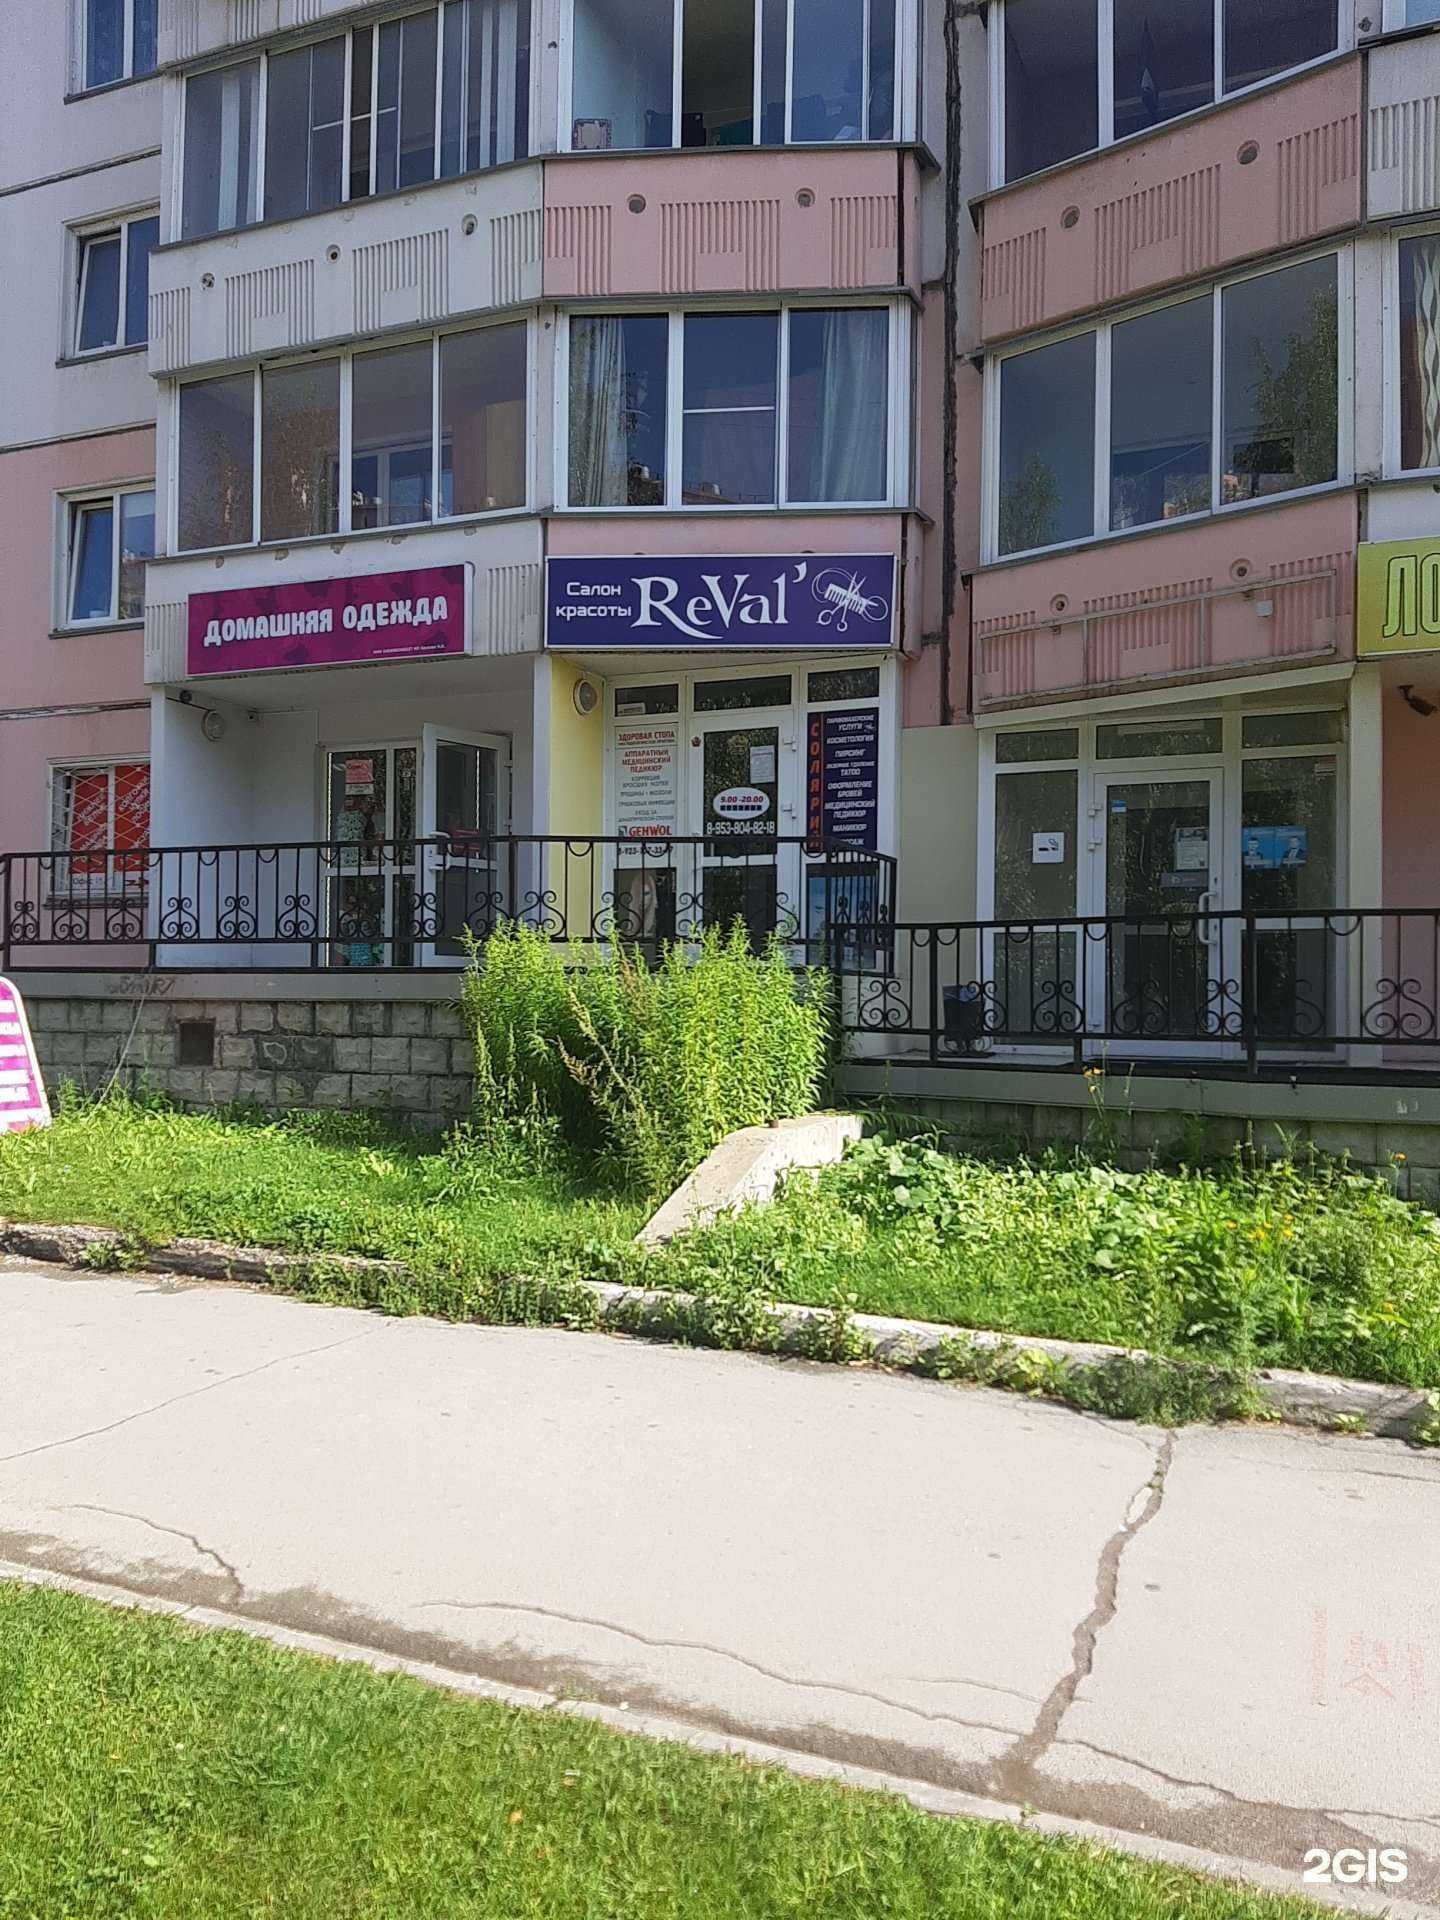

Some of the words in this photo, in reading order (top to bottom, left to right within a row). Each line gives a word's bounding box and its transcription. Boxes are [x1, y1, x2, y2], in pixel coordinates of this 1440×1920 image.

[566, 582, 621, 597] Салон
[203, 608, 333, 647] ДОМАШНЯЯ
[342, 595, 448, 632] ОДЕЖДА
[555, 605, 632, 621] красоты
